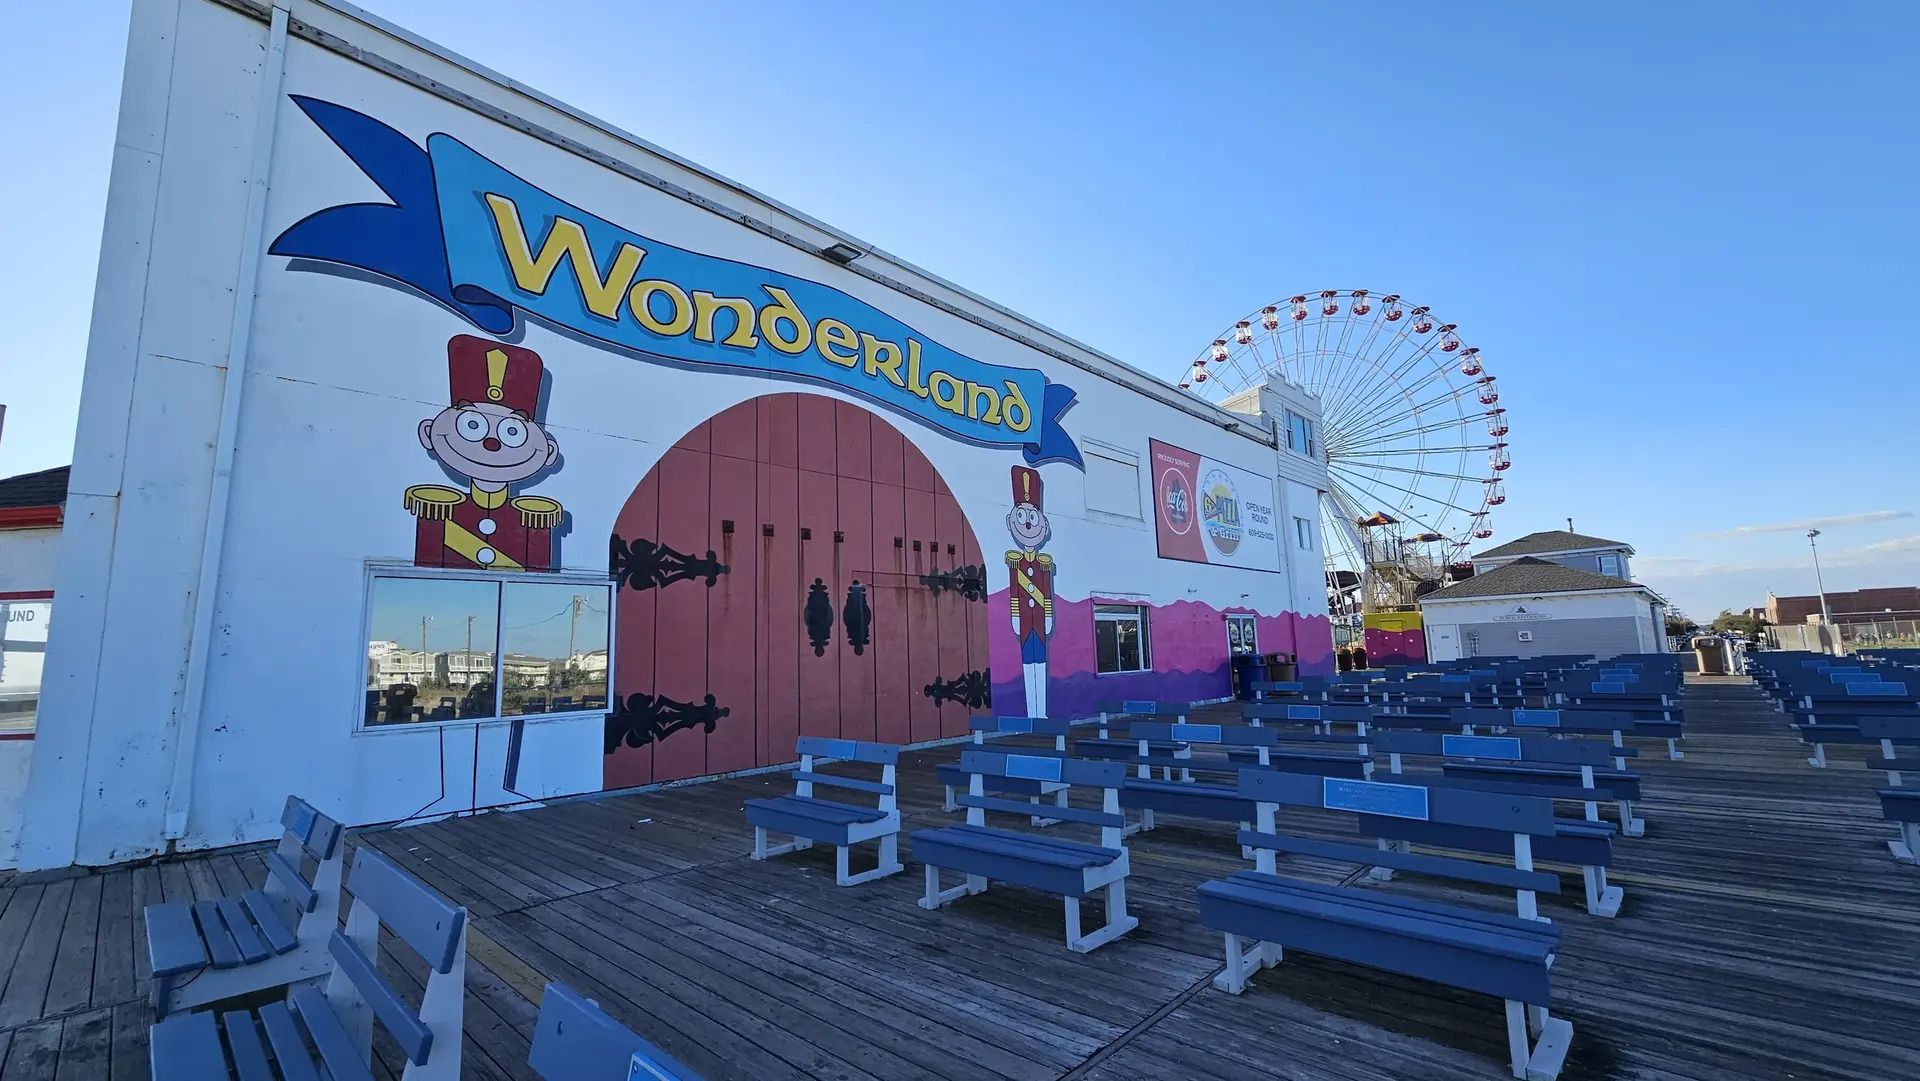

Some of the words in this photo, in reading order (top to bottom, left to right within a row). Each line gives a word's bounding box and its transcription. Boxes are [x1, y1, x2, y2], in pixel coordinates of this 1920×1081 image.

[484, 192, 1031, 433] Wonderland
[1215, 494, 1240, 527] PIZZA
[1246, 501, 1259, 513] OPEN
[1259, 504, 1272, 516] YEAR
[1252, 513, 1269, 525] ROUND
